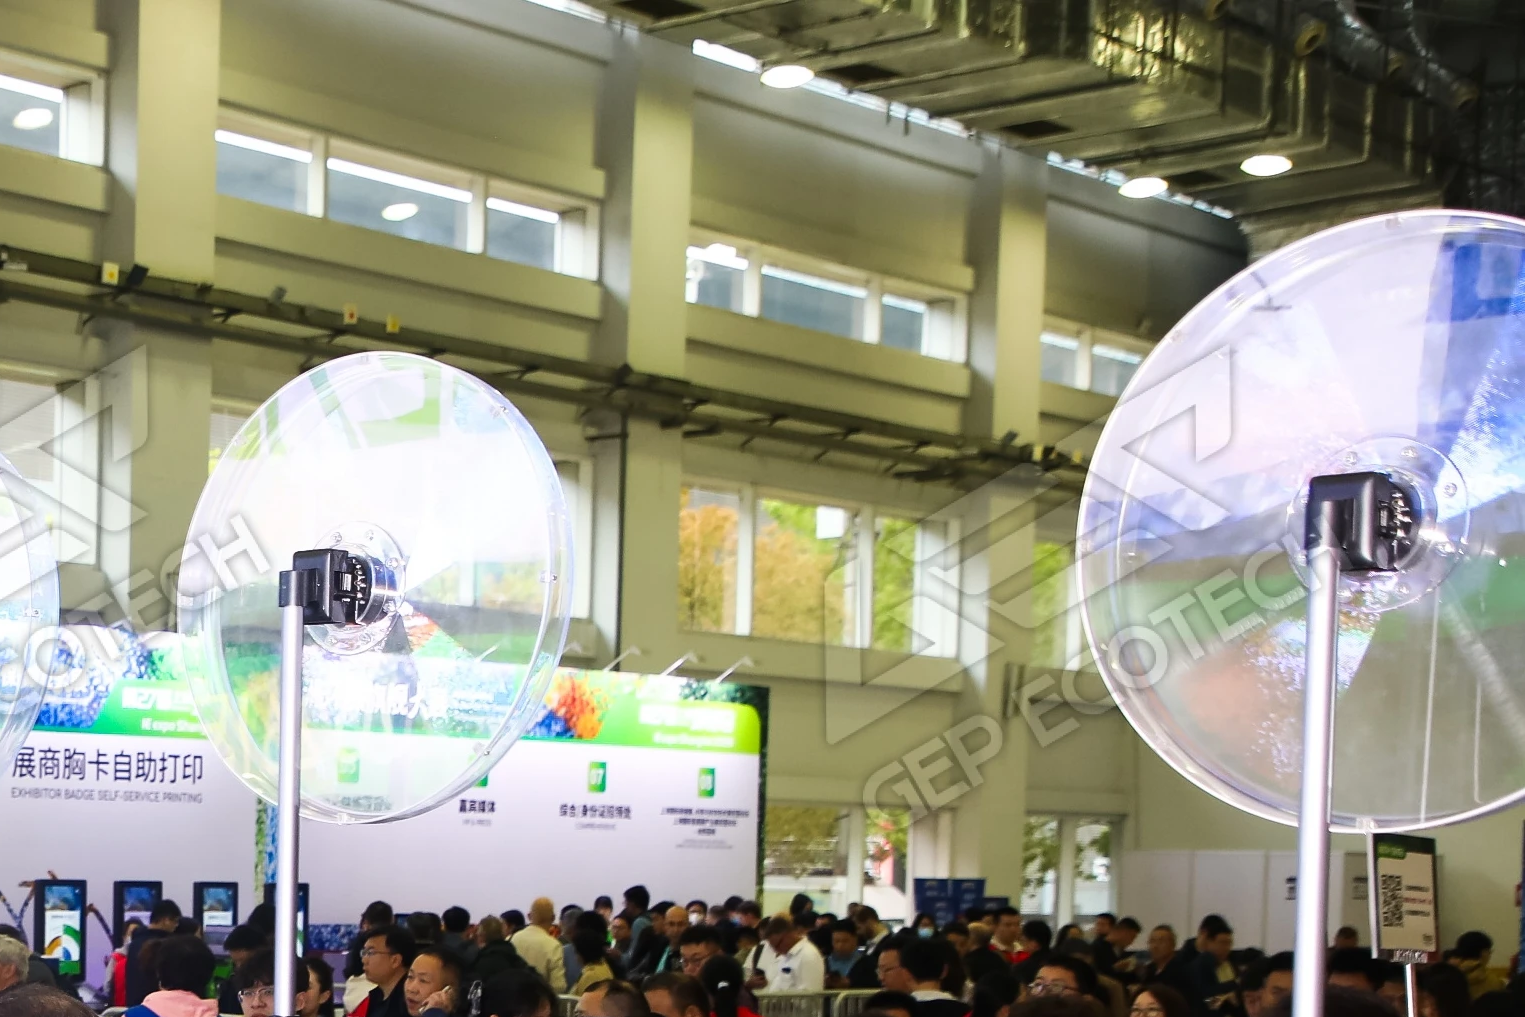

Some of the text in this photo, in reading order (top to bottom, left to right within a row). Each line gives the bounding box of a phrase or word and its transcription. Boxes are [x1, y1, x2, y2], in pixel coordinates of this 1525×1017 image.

[12, 747, 203, 784] 展商胸卡自助打印
[11, 787, 203, 804] EXHIBITOR BADGE SELF-SERVICE PRINTING
